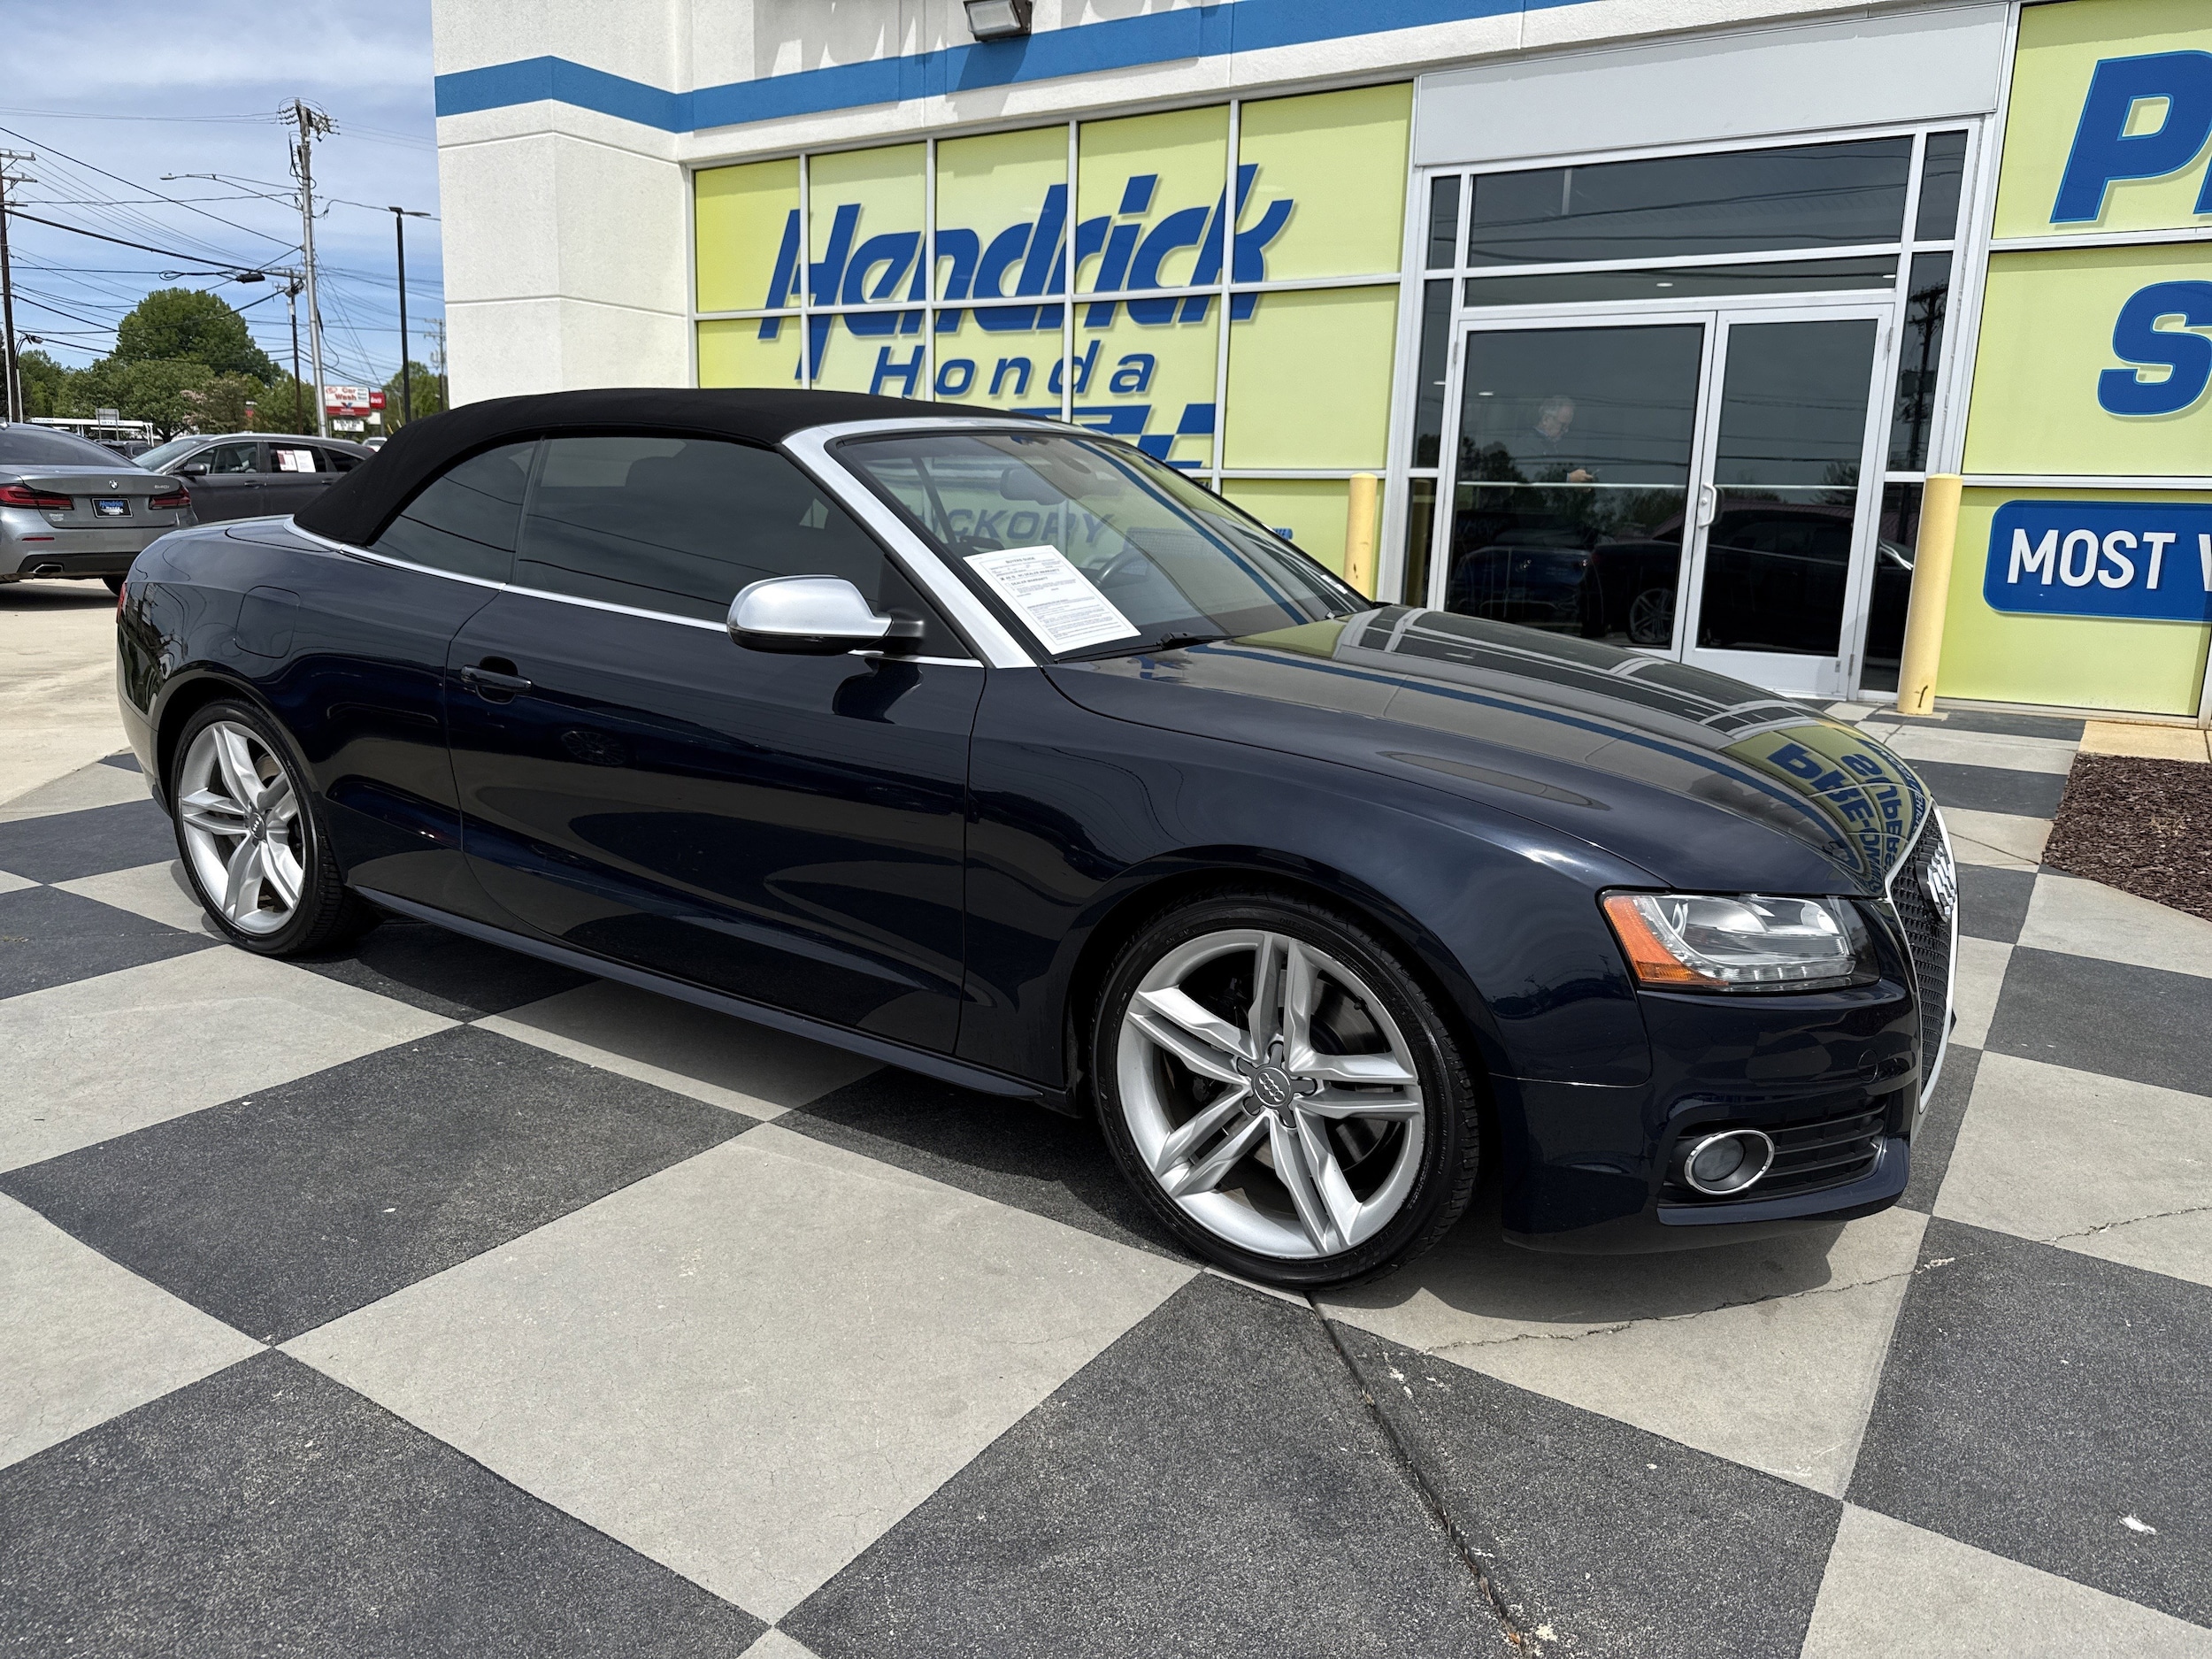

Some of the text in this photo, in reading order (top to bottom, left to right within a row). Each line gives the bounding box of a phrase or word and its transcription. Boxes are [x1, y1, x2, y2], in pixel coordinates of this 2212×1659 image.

[757, 163, 1294, 380] Hendrick
[870, 340, 1155, 396] Honda
[2007, 528, 2177, 589] MOST
